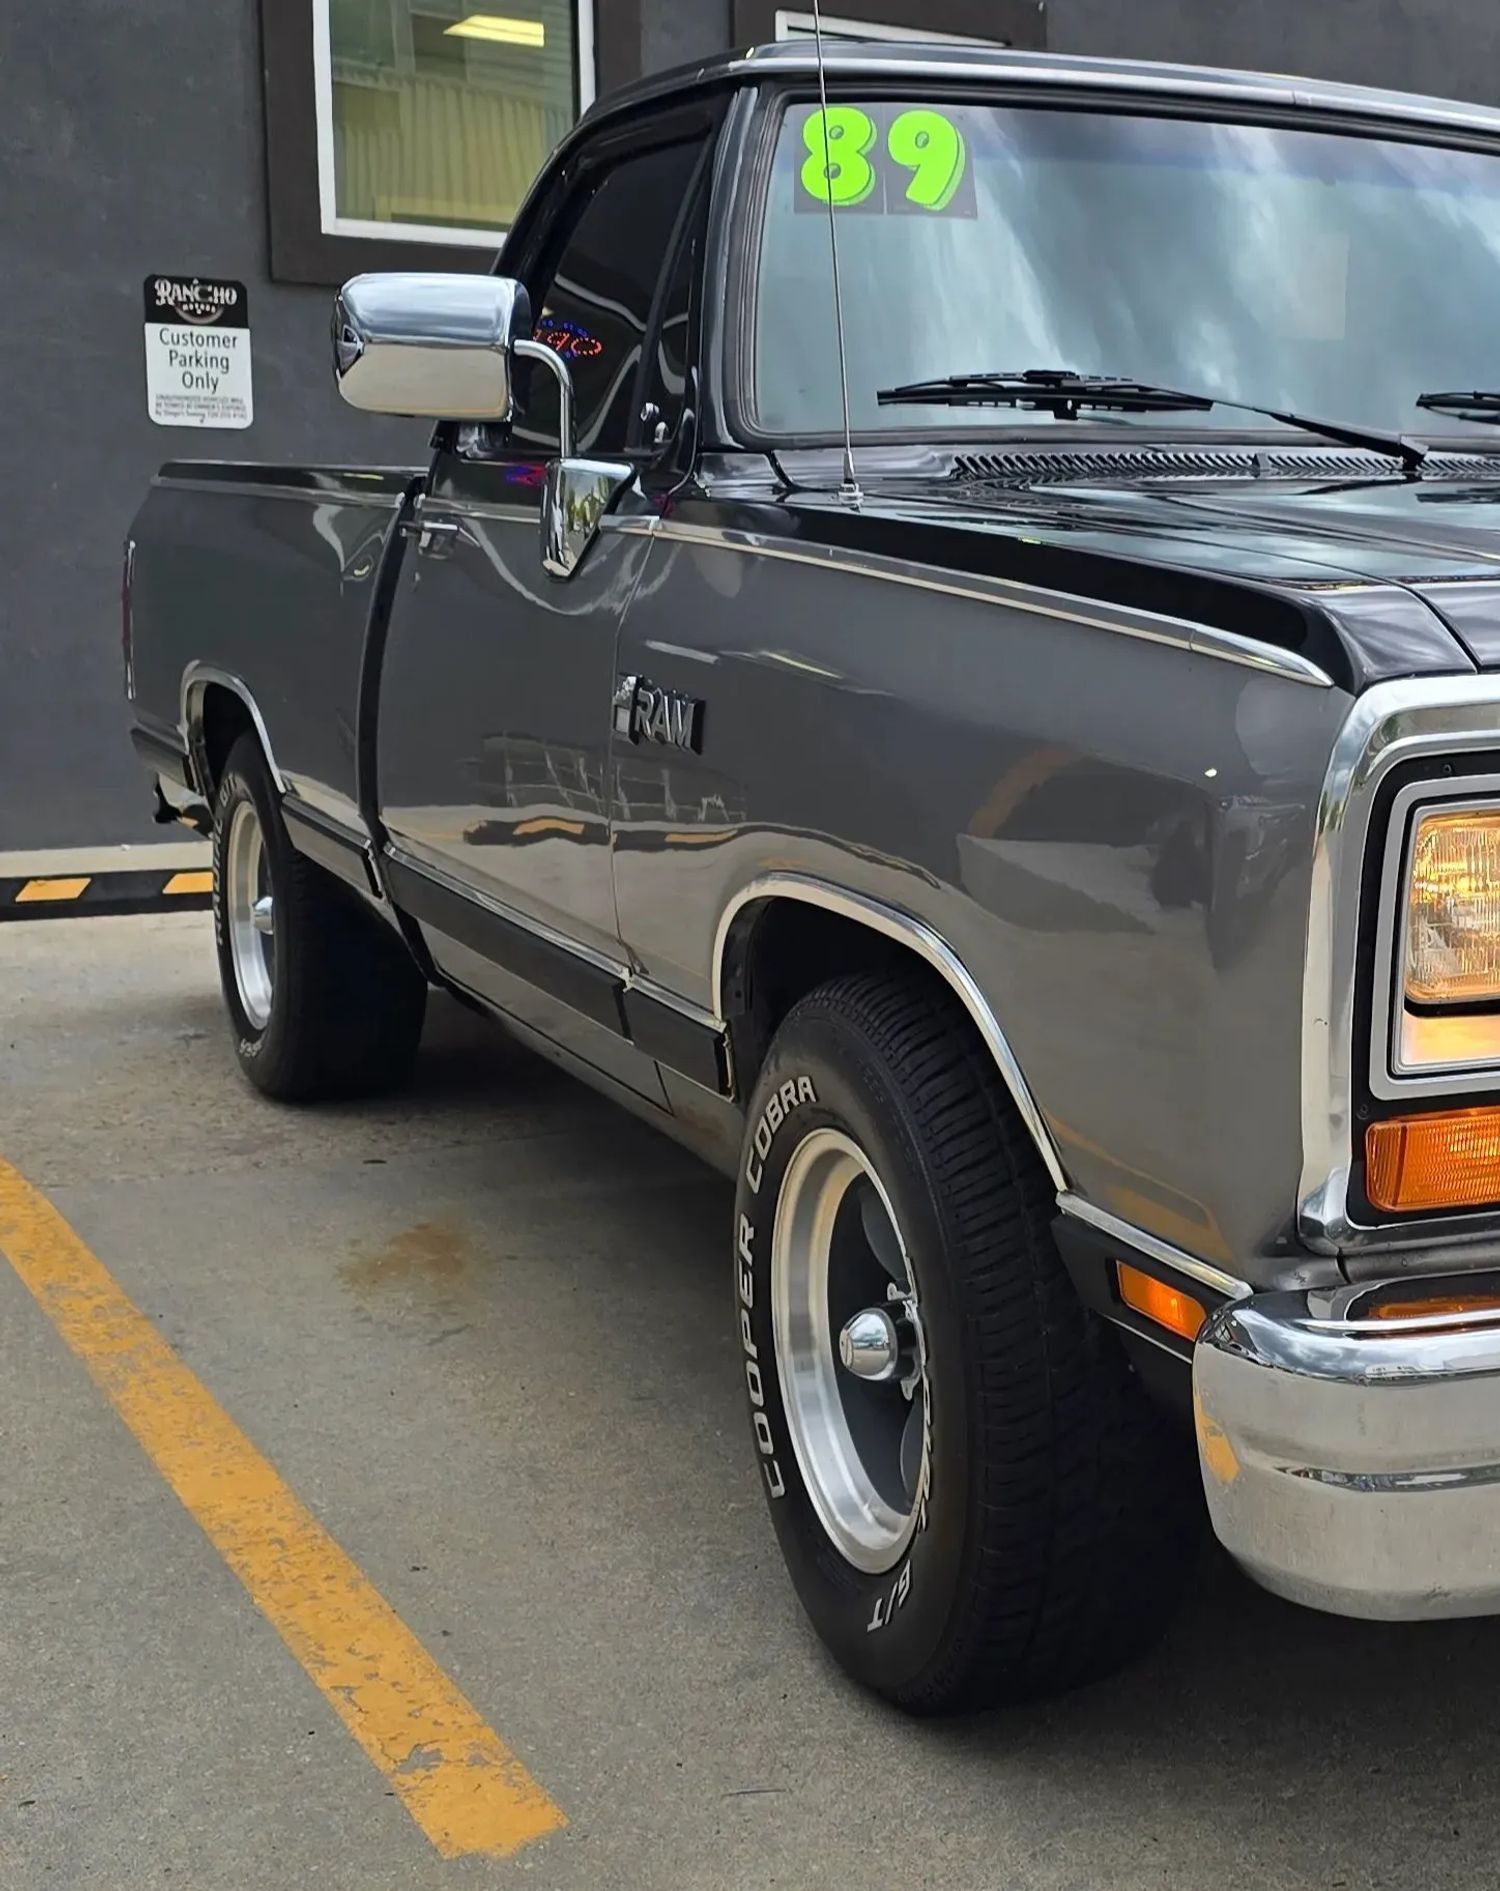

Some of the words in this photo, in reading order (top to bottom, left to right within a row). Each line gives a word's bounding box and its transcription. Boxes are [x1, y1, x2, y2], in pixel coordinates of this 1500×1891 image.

[801, 106, 965, 211] 89
[154, 278, 238, 306] RANCHO
[159, 327, 238, 349] Customer
[169, 350, 230, 375] Parking
[181, 371, 220, 395] Only
[634, 686, 697, 750] RAM
[745, 1075, 818, 1195] COBRA
[737, 1212, 787, 1499] COOPER
